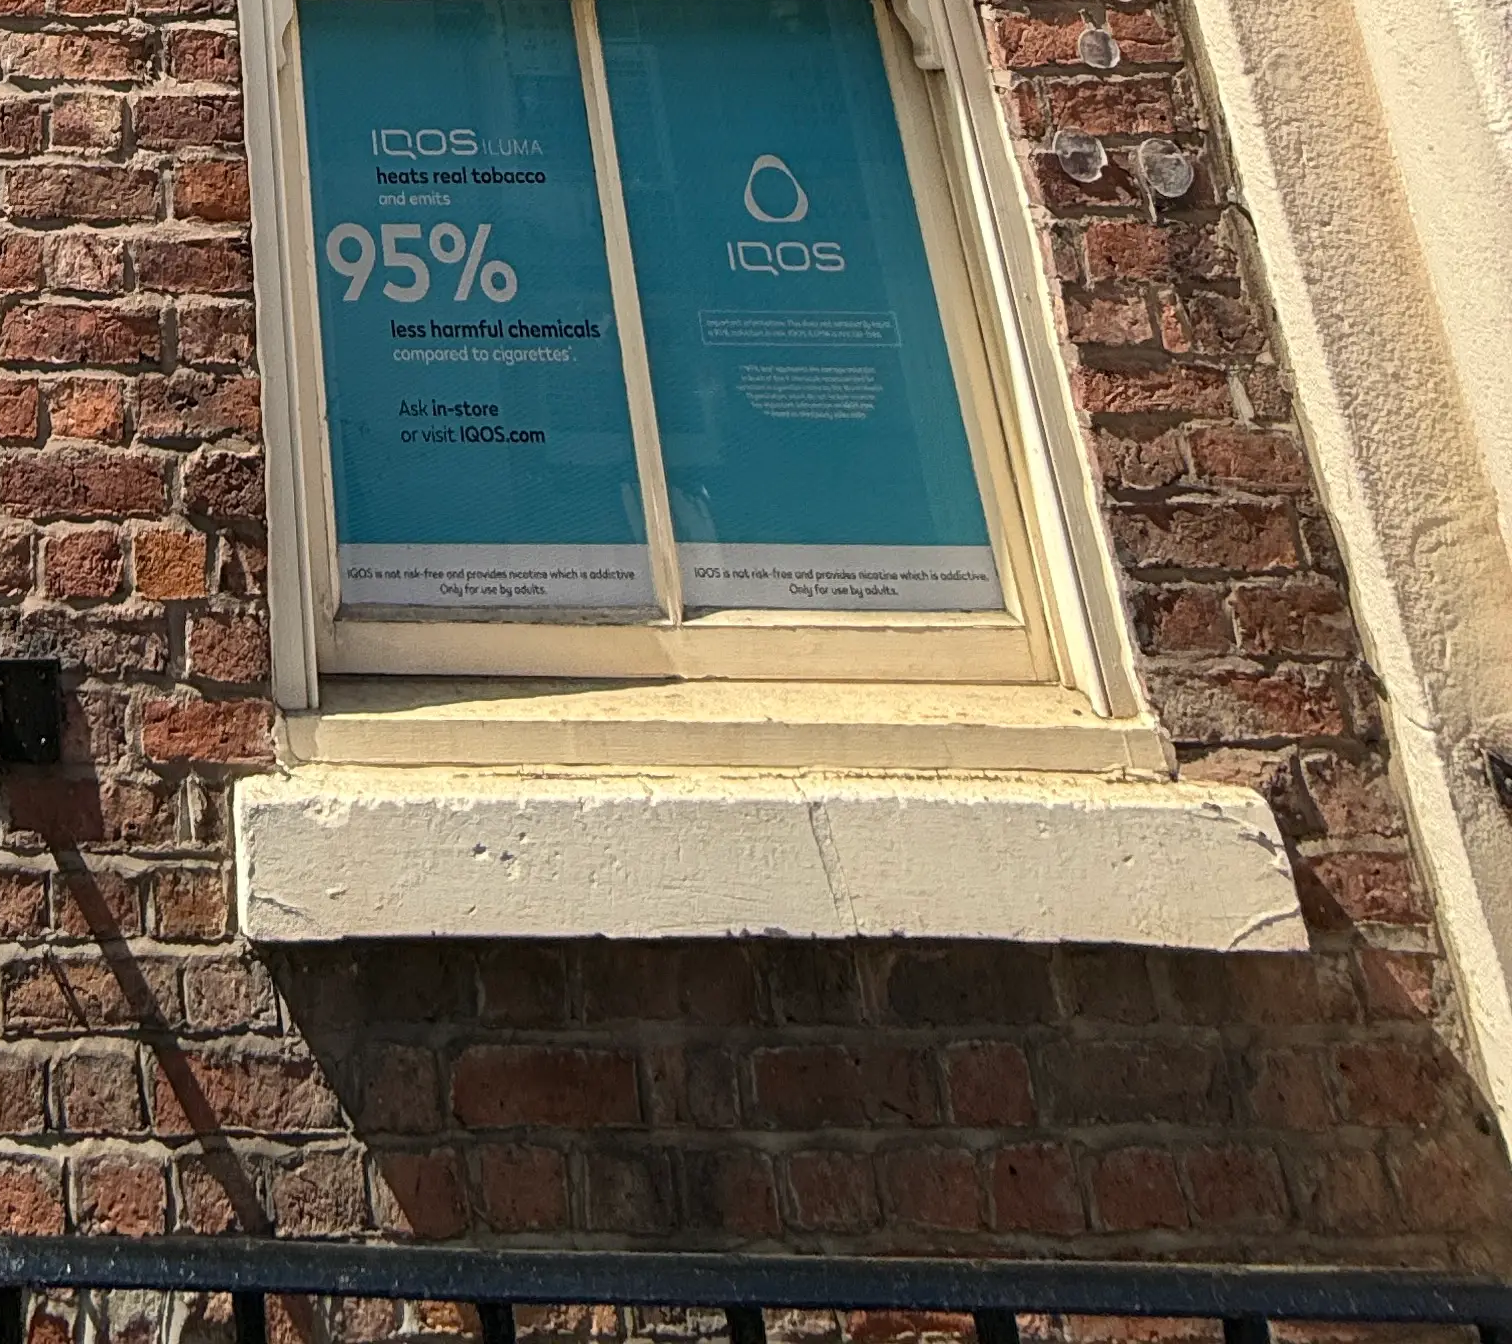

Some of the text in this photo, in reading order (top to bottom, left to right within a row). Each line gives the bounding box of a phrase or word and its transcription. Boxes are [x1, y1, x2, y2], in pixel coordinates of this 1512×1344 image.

[370, 129, 544, 160] IQOS ILUMA
[375, 165, 546, 185] heats real tobacco
[379, 190, 452, 206] and emits
[326, 221, 518, 303] 95%
[726, 241, 846, 276] IQOS
[390, 318, 601, 339] less harmful chemicals
[392, 345, 469, 365] compared
[471, 347, 489, 362] to
[399, 398, 499, 417] Ask in-store
[400, 424, 546, 444] or visit IQOS.com
[694, 567, 721, 578] IQOS
[732, 568, 750, 579] not
[752, 567, 793, 580] risk-free
[795, 568, 814, 579] and
[900, 569, 929, 581] which
[439, 582, 463, 597] Only
[465, 583, 478, 595] for
[480, 586, 497, 595] use
[499, 583, 513, 598] by
[789, 582, 814, 597] Only
[814, 583, 828, 595] for
[831, 586, 848, 595] use
[849, 585, 863, 598] by
